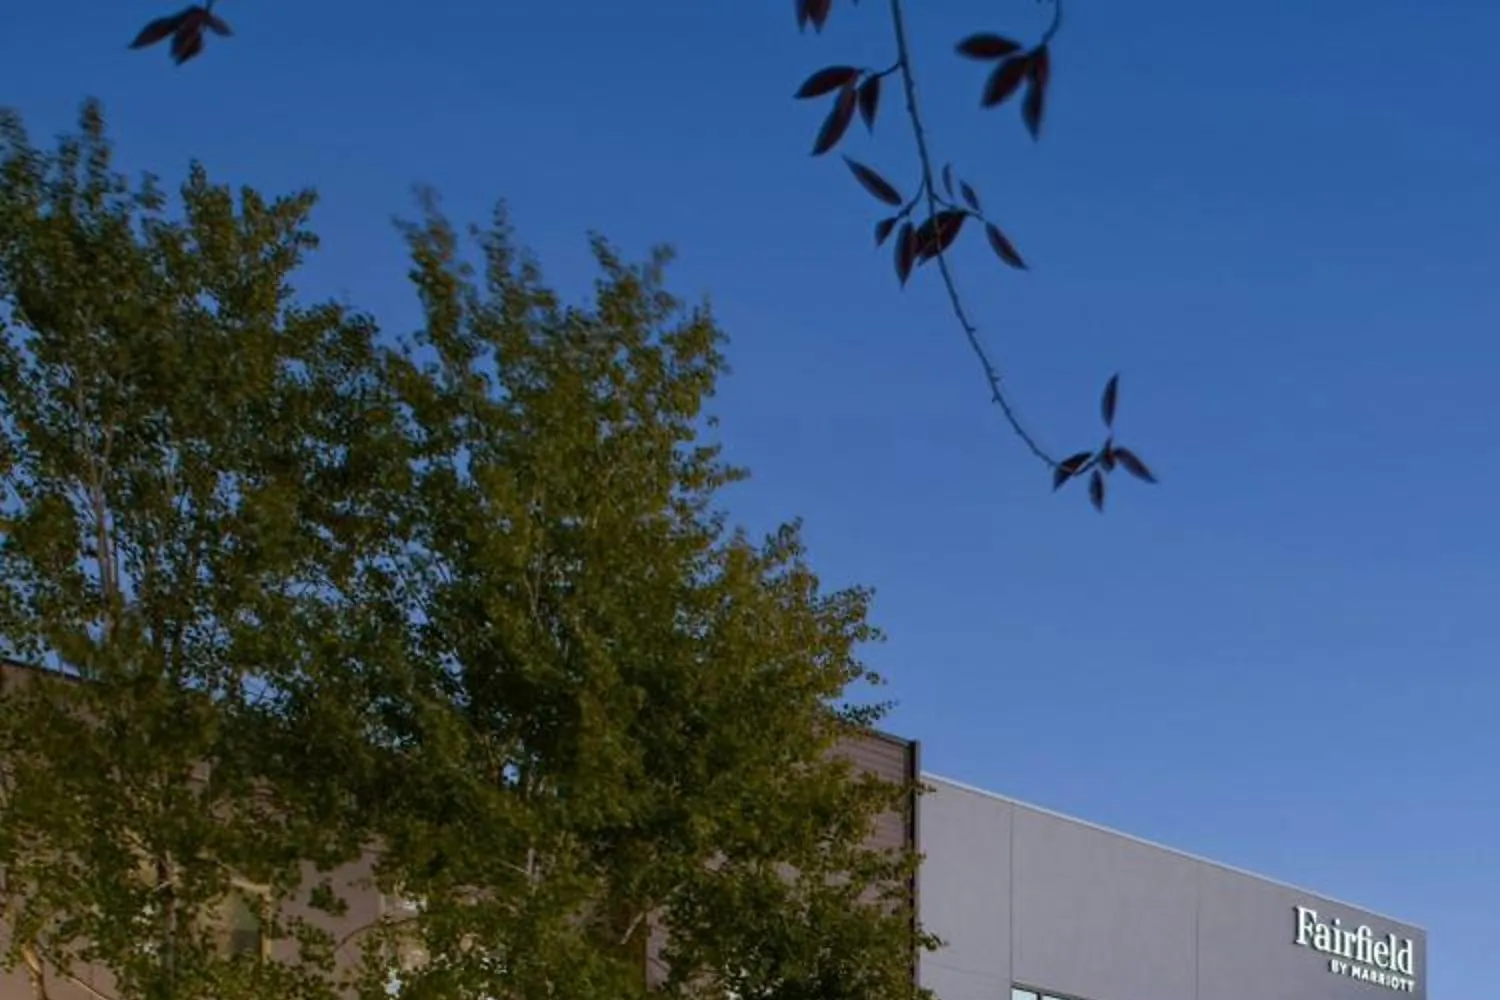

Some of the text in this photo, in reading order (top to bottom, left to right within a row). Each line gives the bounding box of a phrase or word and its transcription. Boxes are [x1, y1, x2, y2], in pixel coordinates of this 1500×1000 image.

[1295, 905, 1415, 975] Fairfield
[1330, 959, 1415, 993] BY MARRIOTT
